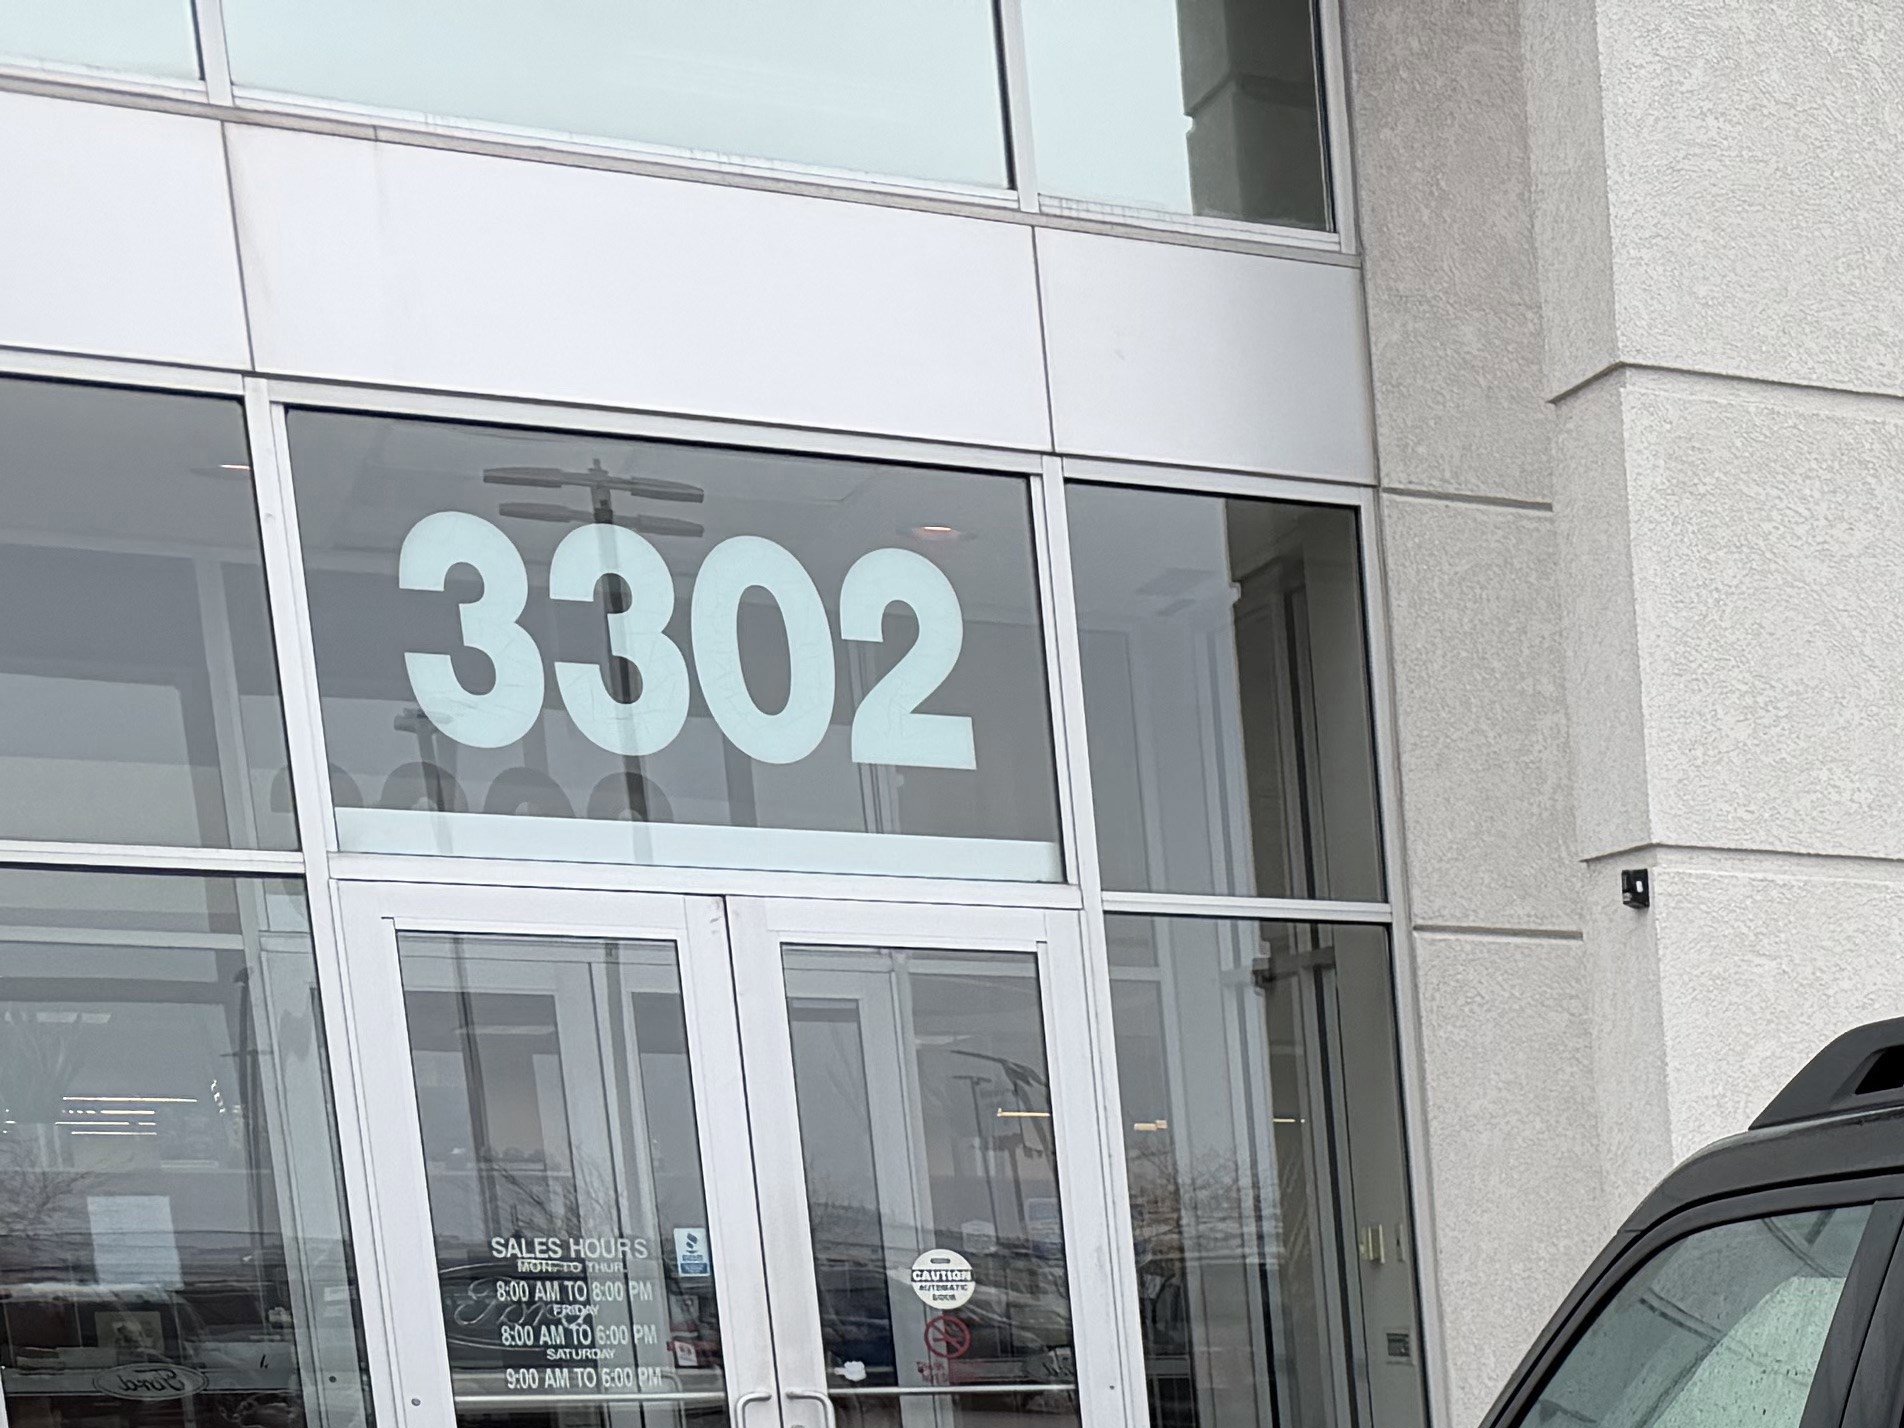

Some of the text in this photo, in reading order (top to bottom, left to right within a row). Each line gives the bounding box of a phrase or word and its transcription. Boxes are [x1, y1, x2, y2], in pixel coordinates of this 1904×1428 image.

[399, 511, 977, 770] 3302
[491, 1236, 649, 1259] SALES HOURS
[562, 1262, 582, 1273] TO
[912, 1270, 972, 1281] CAUTION
[496, 1281, 654, 1301] 8:00 AM TO 8:00 PM
[553, 1303, 600, 1316] FRIDAY
[501, 1325, 658, 1346] 8:00 AM TO 6:00 PM
[546, 1348, 617, 1360] SATURDAY
[506, 1368, 662, 1389] 9:00 AM TO 6:00 PM
